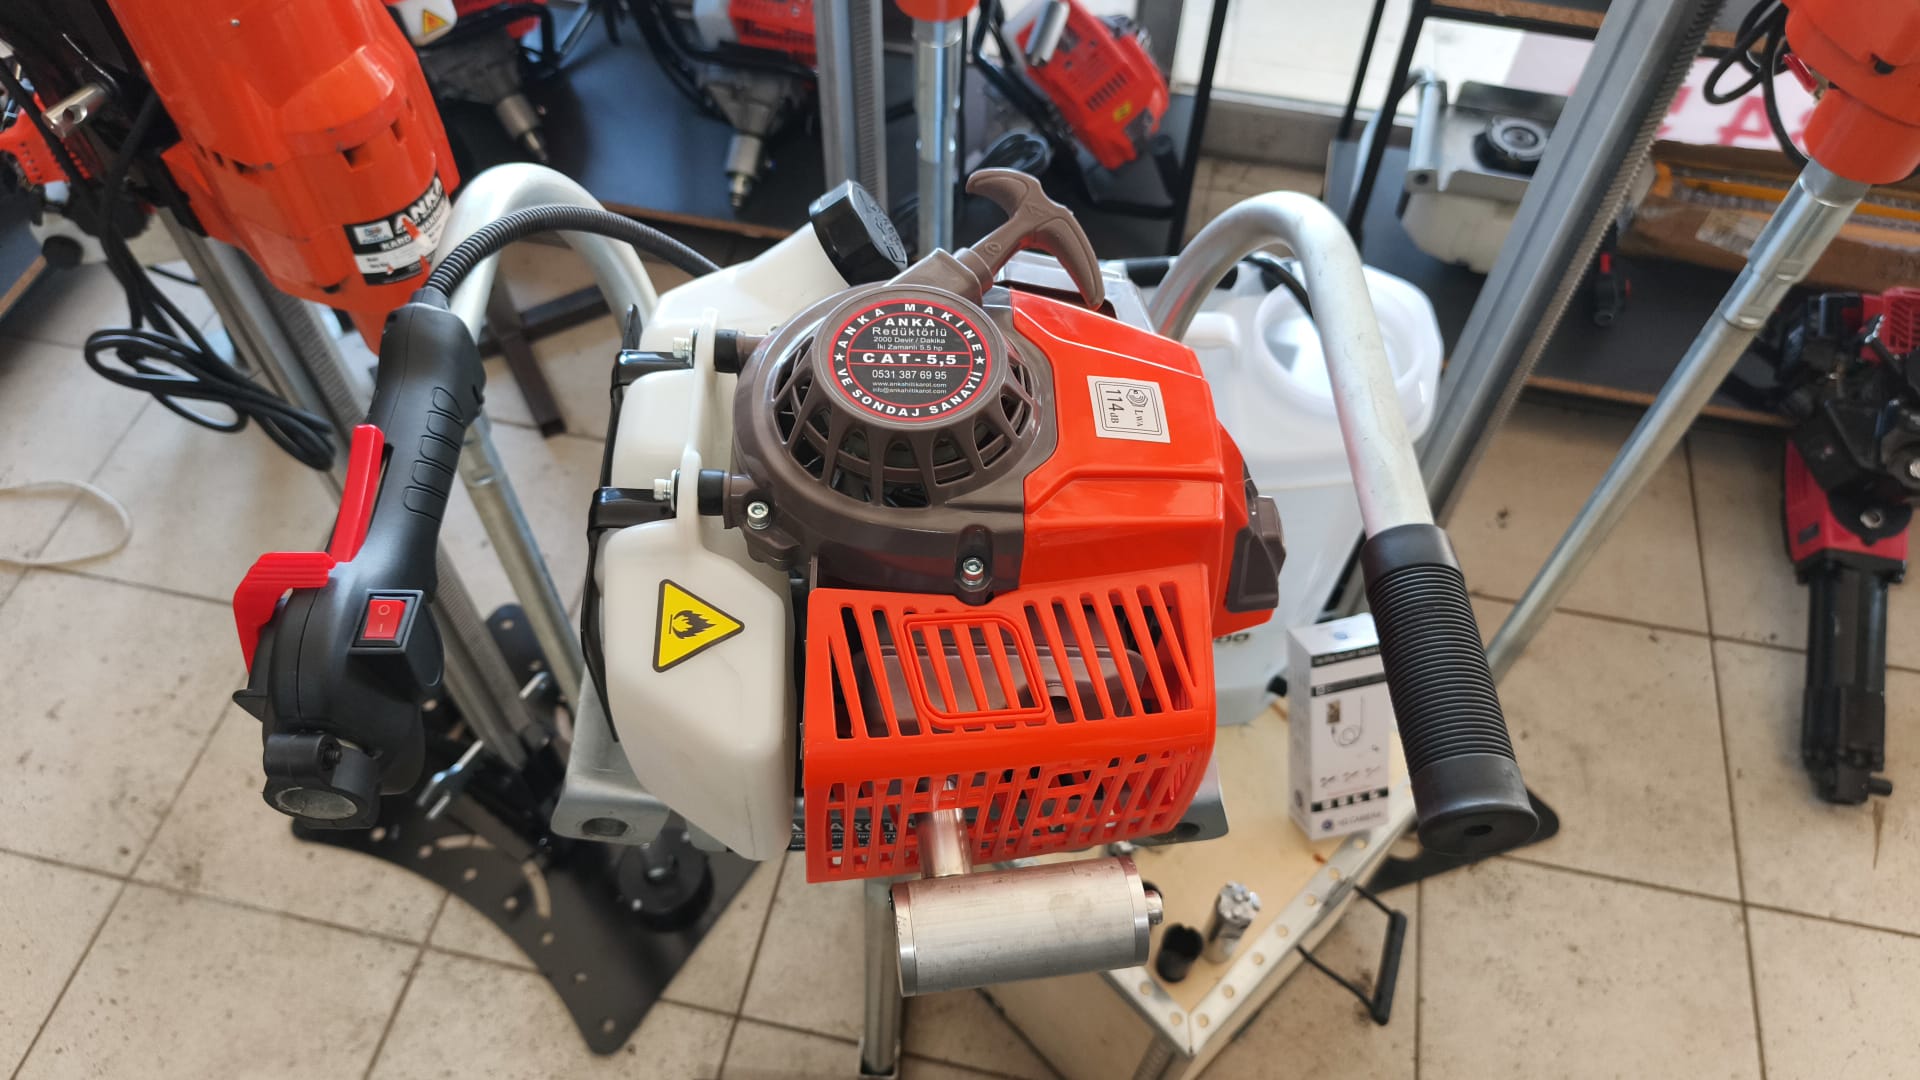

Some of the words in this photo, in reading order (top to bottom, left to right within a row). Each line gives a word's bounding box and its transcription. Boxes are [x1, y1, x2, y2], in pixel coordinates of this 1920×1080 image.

[885, 317, 935, 327] ANKA
[837, 308, 885, 348] ANKA
[872, 327, 947, 337] Redüktörlü
[872, 369, 896, 379] 0531
[899, 370, 917, 379] 387
[919, 370, 932, 380] 69
[934, 371, 947, 380] 95
[837, 368, 853, 386] VE
[852, 389, 920, 417] SONDAJ
